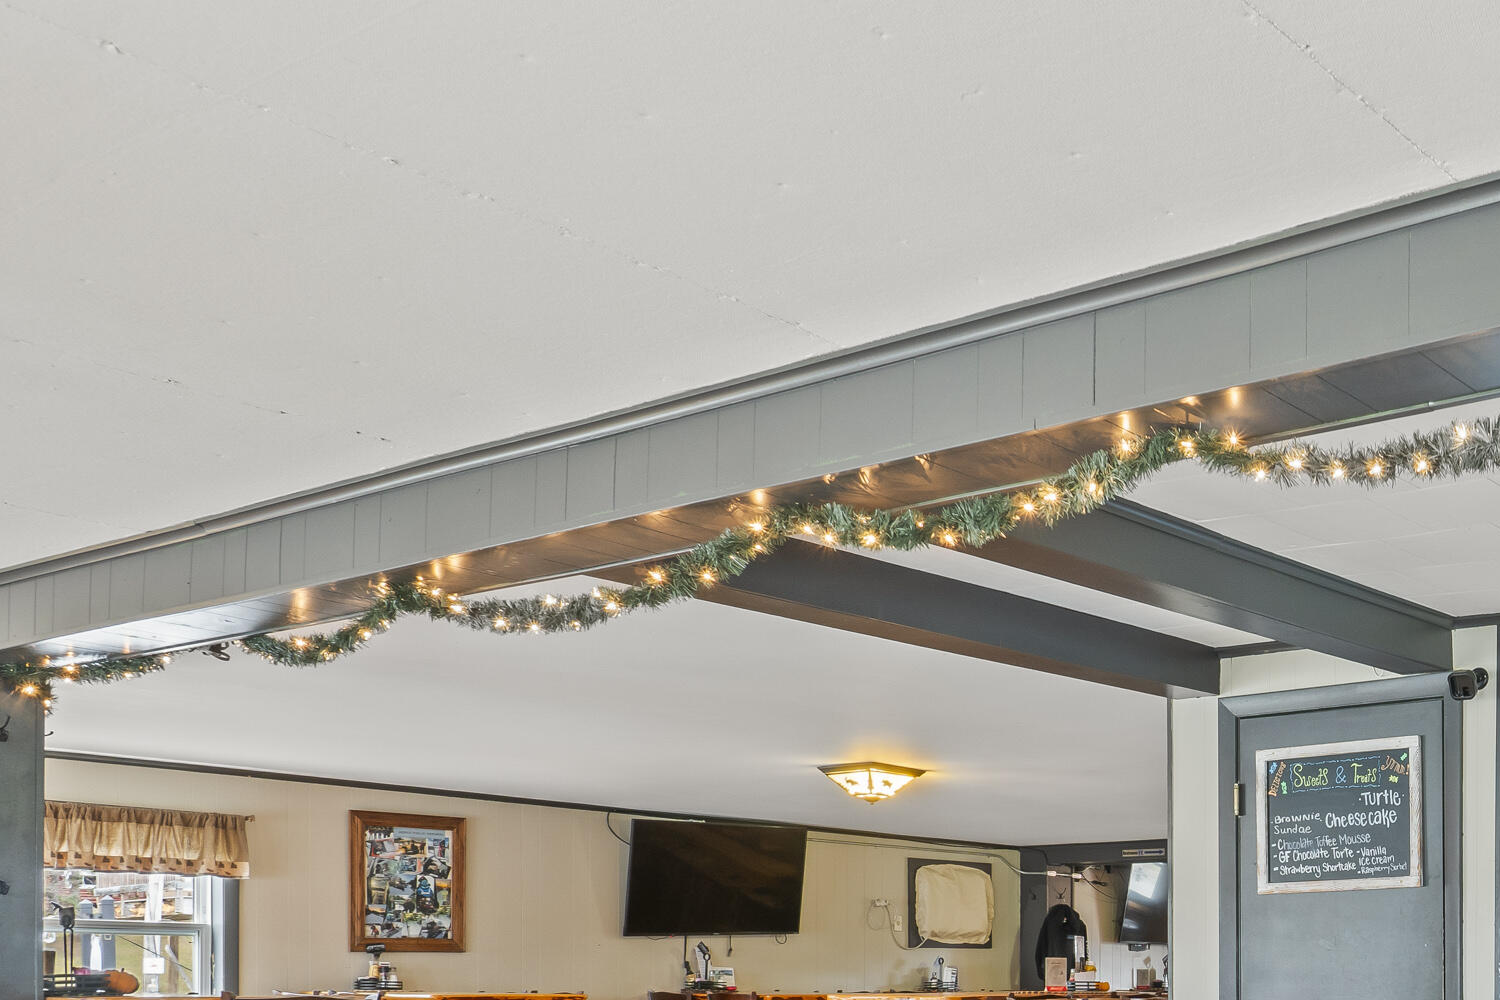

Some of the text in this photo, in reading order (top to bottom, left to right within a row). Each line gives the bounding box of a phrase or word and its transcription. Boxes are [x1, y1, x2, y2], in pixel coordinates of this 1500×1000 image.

[1293, 762, 1377, 788] Sweets & Treats
[1361, 790, 1401, 806] Turtle
[1274, 824, 1312, 834] Sundae
[1278, 832, 1371, 851] Chocolate Toffee Mousse
[1278, 847, 1354, 863] GF Chocolate Torte
[1361, 847, 1387, 858] Vanilla
[1372, 854, 1394, 865] cream
[1280, 861, 1356, 878] Strawberry Shortcake
